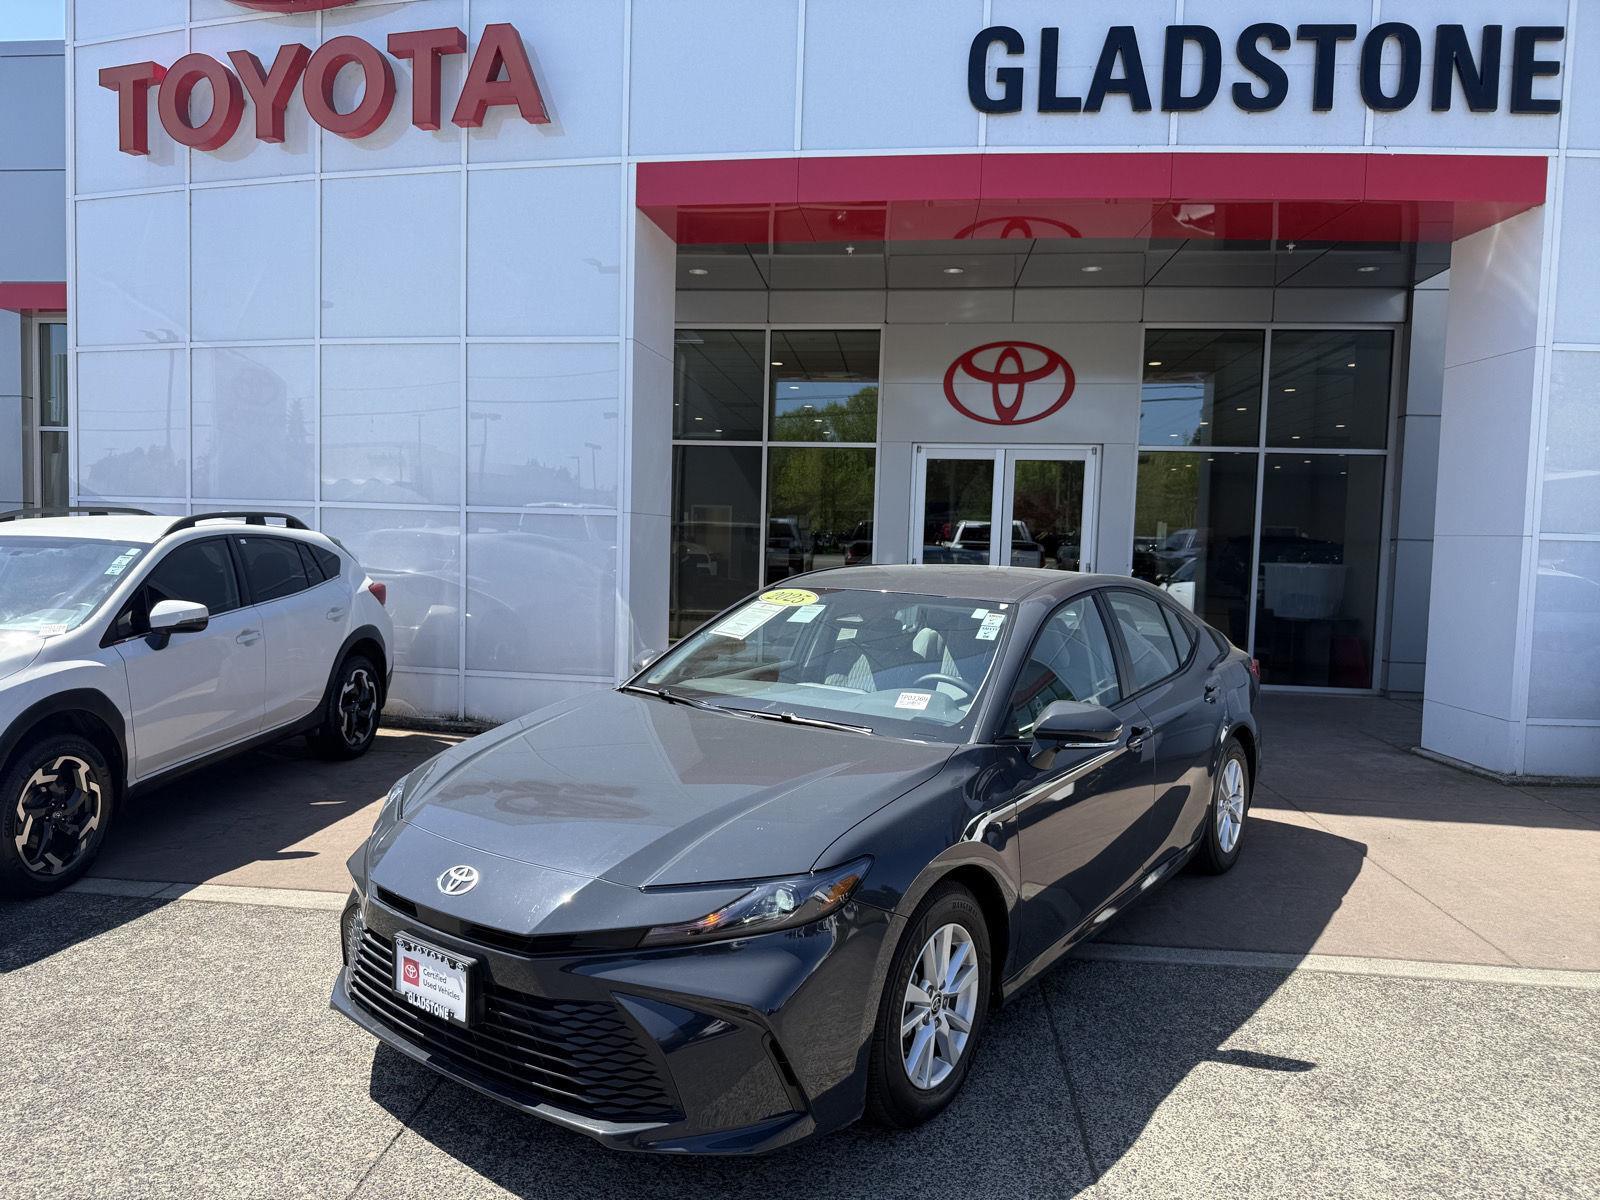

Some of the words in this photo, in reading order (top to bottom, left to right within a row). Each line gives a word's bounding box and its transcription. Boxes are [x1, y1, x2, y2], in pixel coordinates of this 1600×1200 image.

[967, 22, 1565, 115] GLADSTONE
[98, 22, 551, 156] TOYOTA
[423, 968, 447, 984] Certified
[423, 979, 437, 991] Used
[438, 984, 460, 1001] Vehicles
[407, 991, 450, 1020] GLADSTONE
